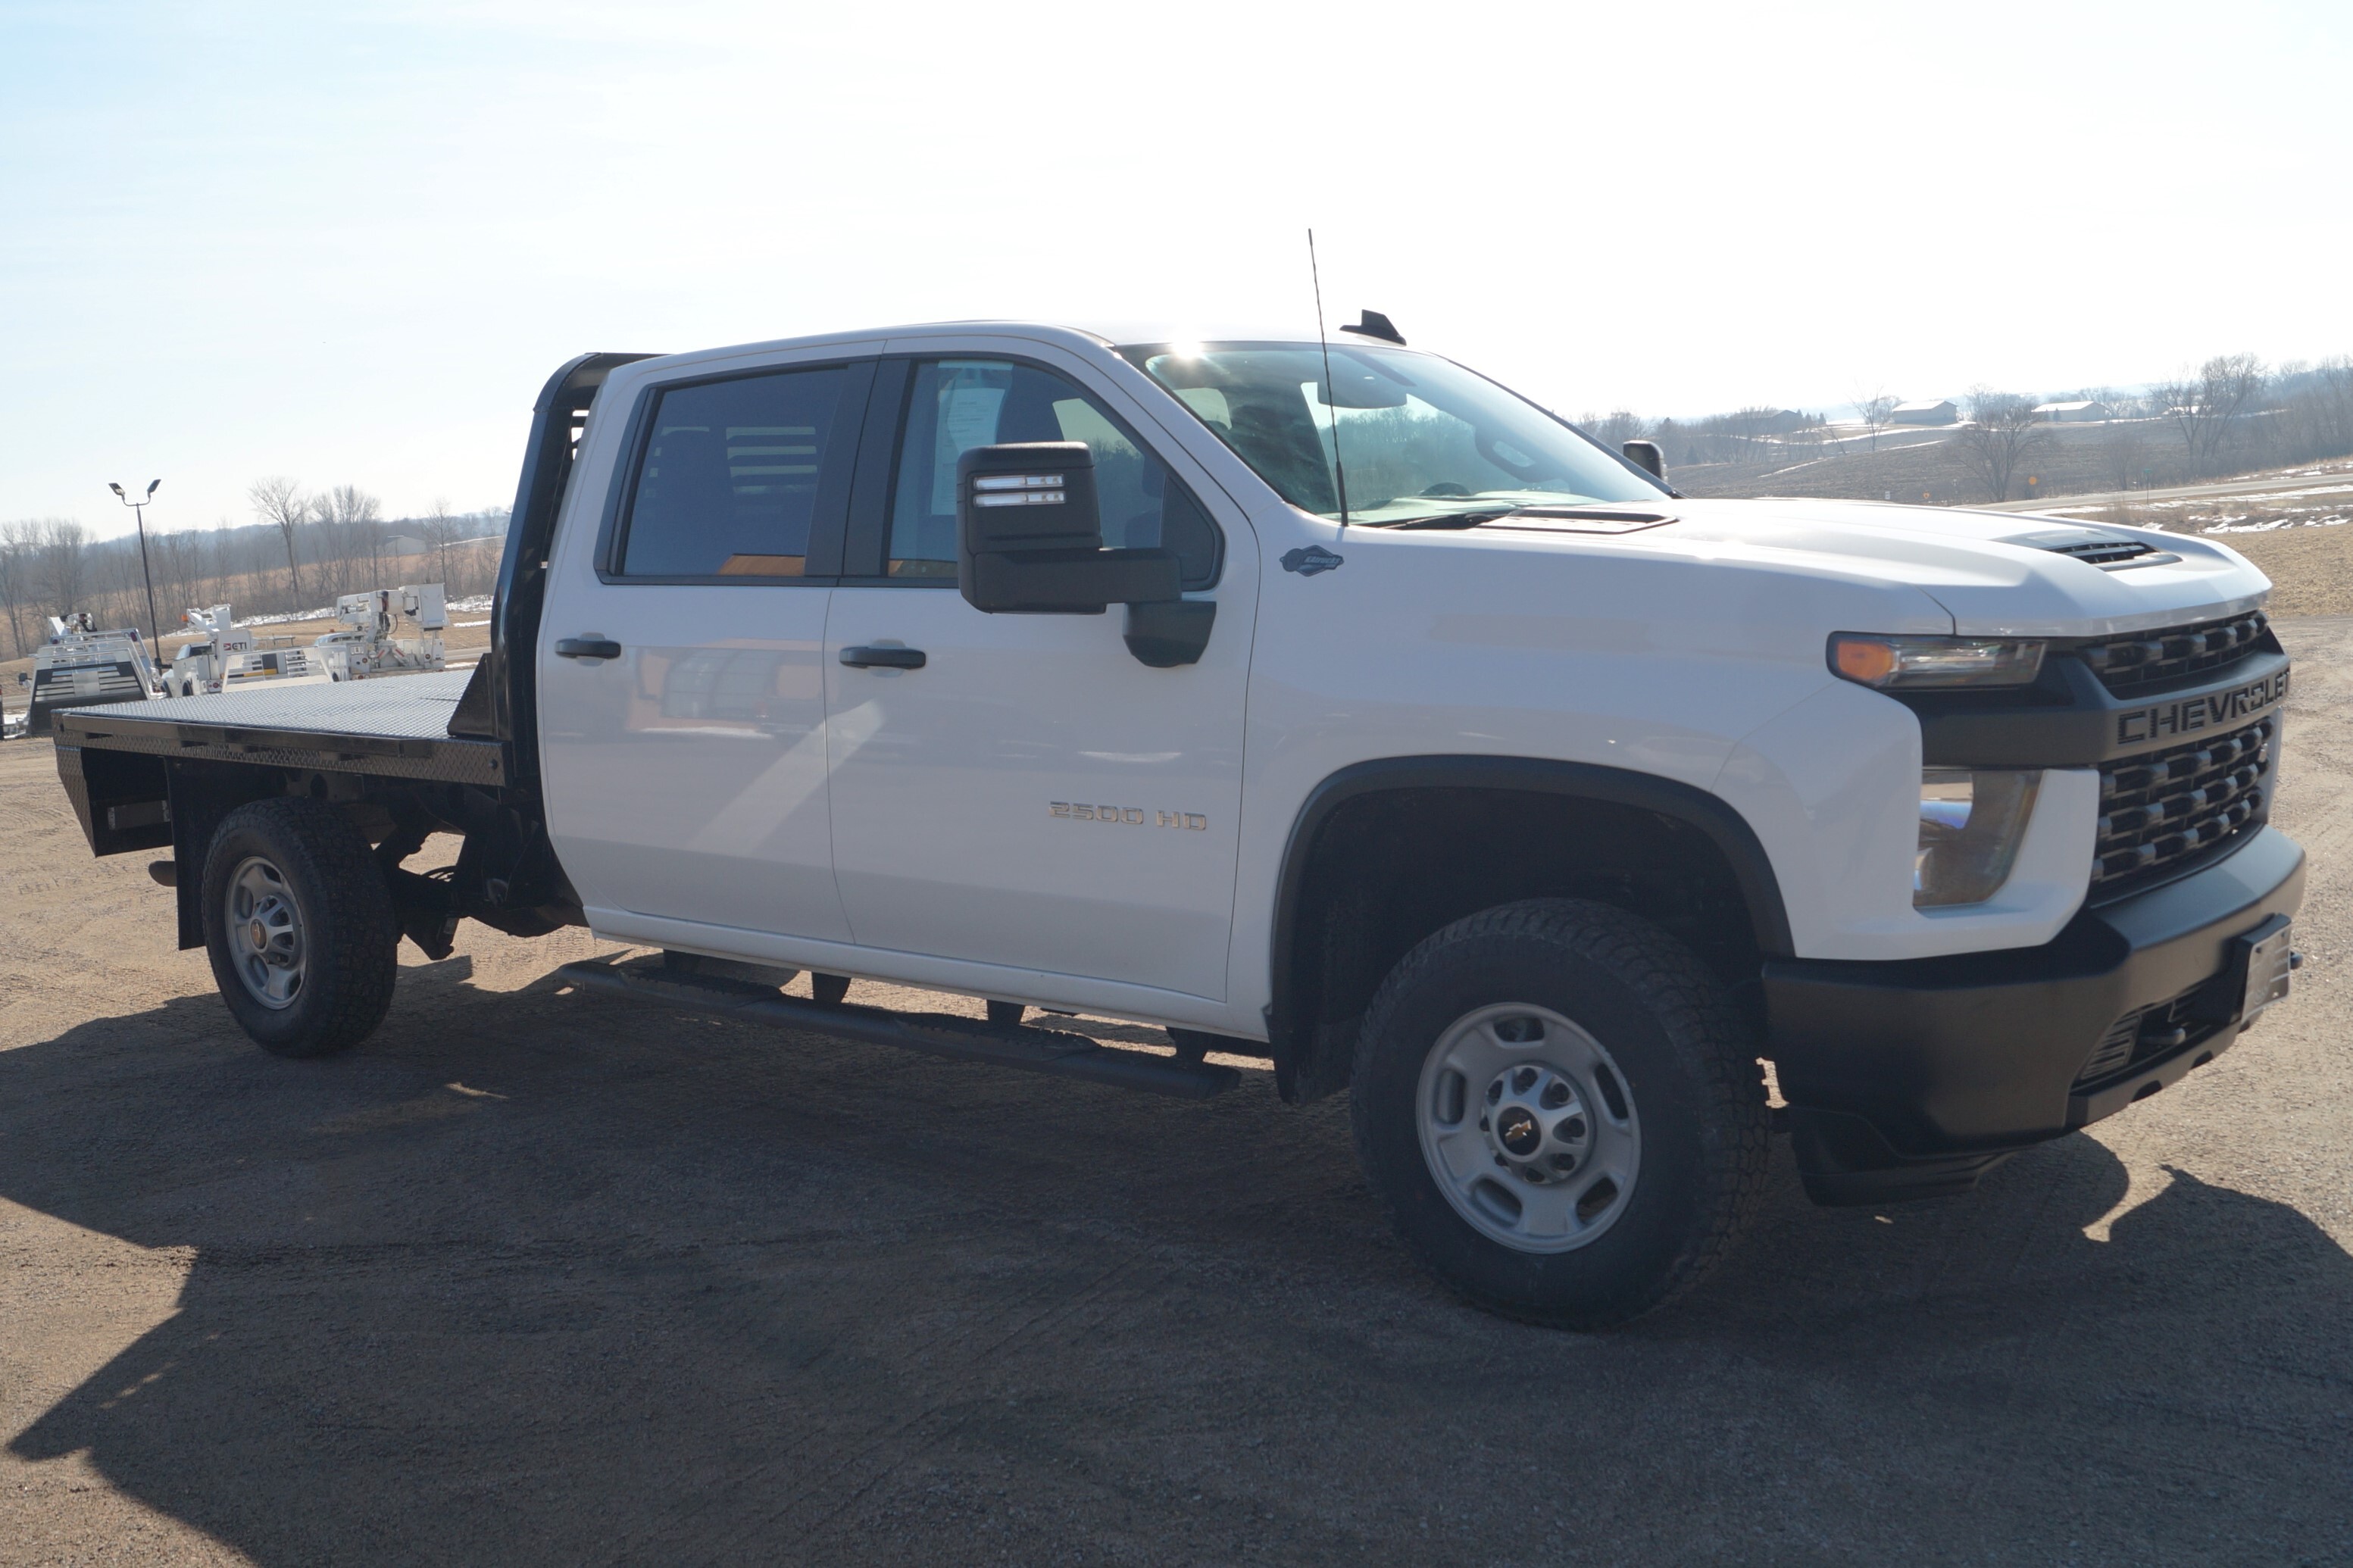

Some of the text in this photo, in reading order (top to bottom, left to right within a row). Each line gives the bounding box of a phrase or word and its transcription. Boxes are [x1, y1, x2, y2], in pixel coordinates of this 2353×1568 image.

[2117, 667, 2290, 745] CHEVROLET
[1048, 801, 1207, 831] 2500 HD
